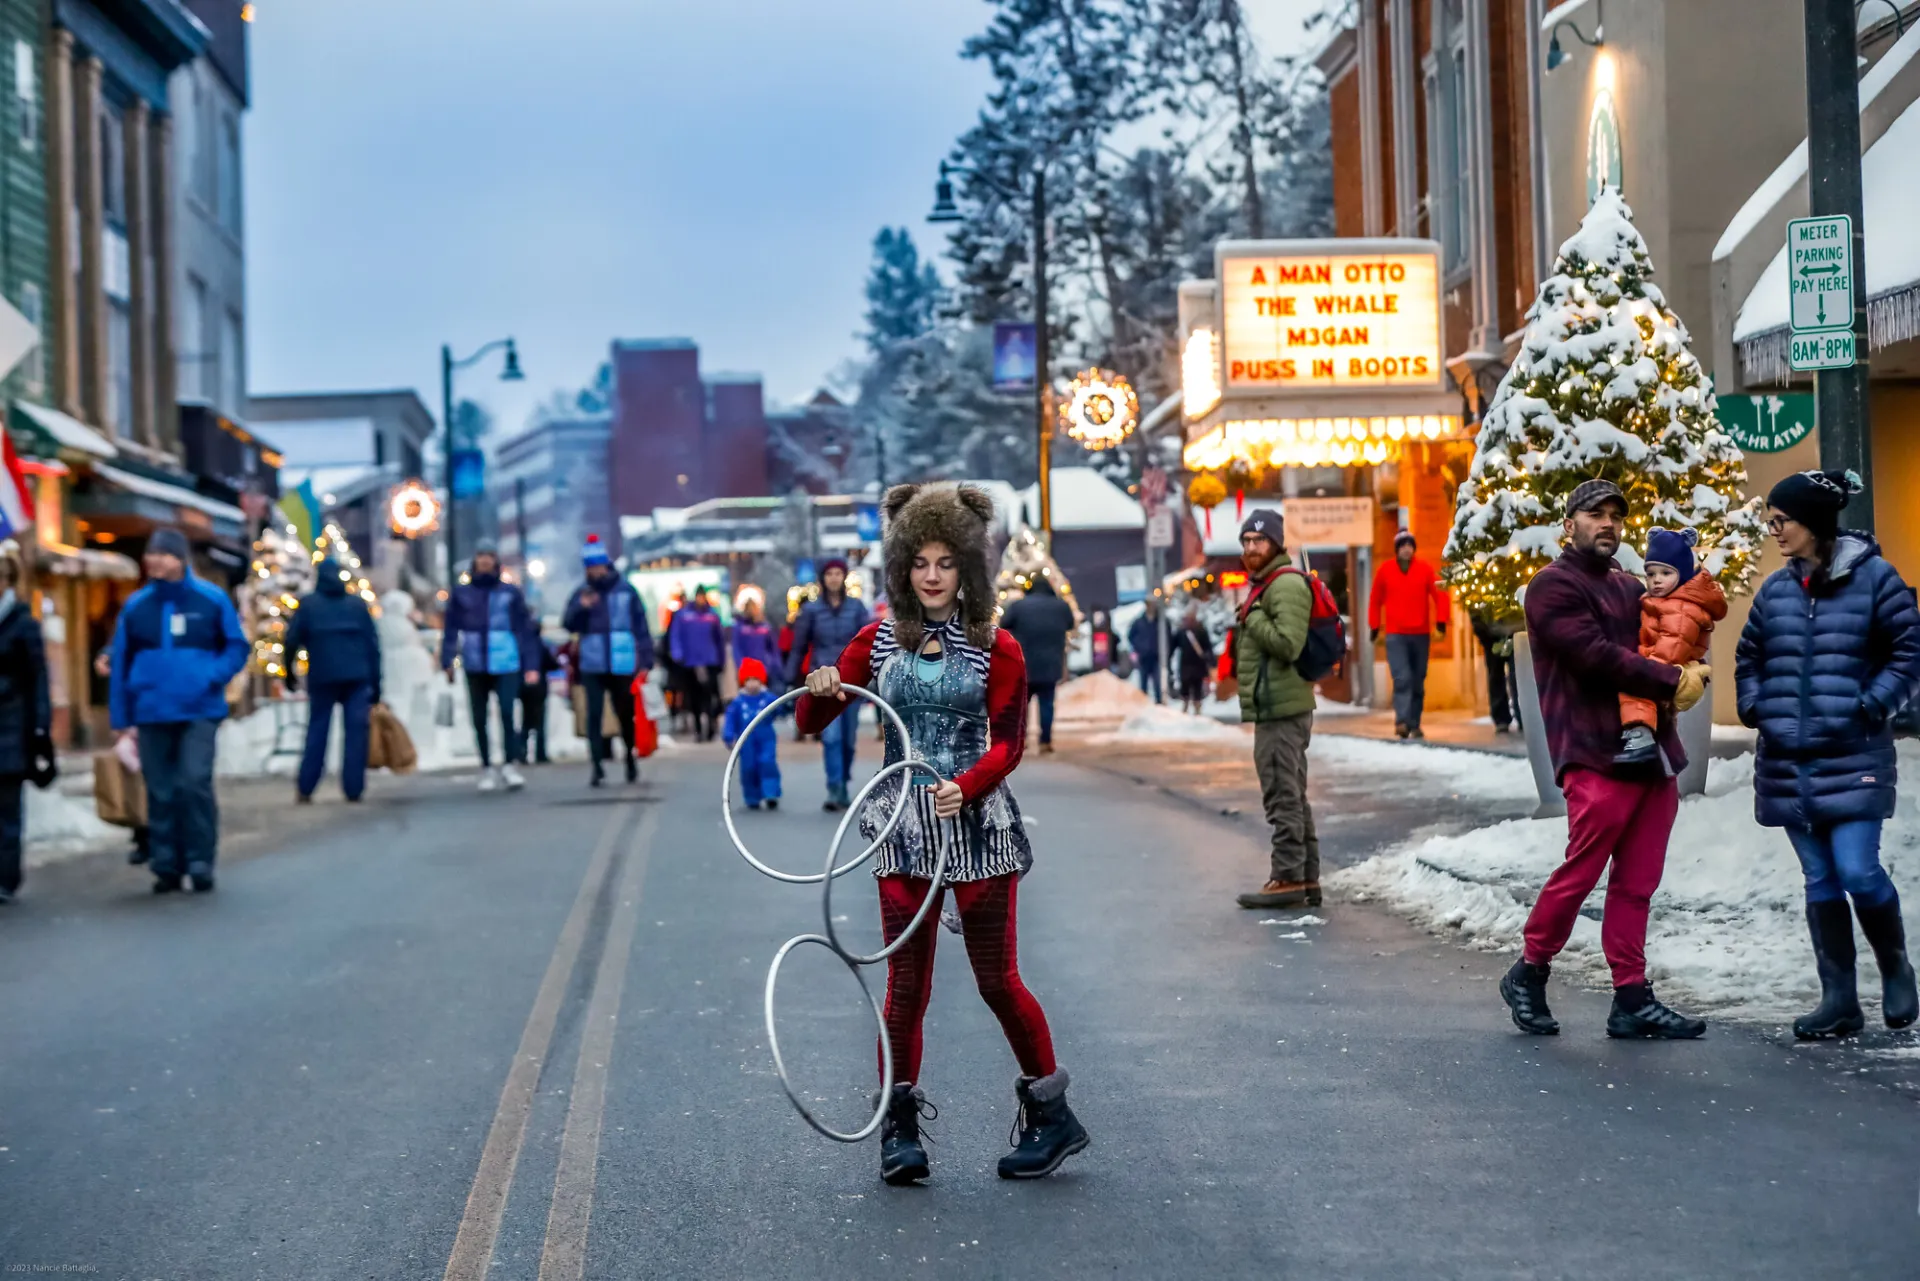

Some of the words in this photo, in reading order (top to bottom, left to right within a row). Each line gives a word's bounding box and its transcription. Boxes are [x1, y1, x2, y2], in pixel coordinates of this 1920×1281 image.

[1799, 224, 1838, 241] METER
[1796, 246, 1843, 263] PARKING
[1250, 265, 1267, 286] A
[1279, 264, 1332, 286] MAN
[1344, 263, 1406, 284] OTTO
[1793, 279, 1814, 294] PAY
[1818, 276, 1848, 291] HERE
[1254, 297, 1297, 317] THE
[1314, 294, 1398, 315] WHALE
[1287, 327, 1369, 347] M3GAN
[1793, 338, 1852, 362] 8AM-8PM
[1231, 359, 1296, 380] PUSS
[1312, 358, 1334, 378] IN
[1349, 356, 1428, 377] BOOTS
[1774, 421, 1805, 449] ATM
